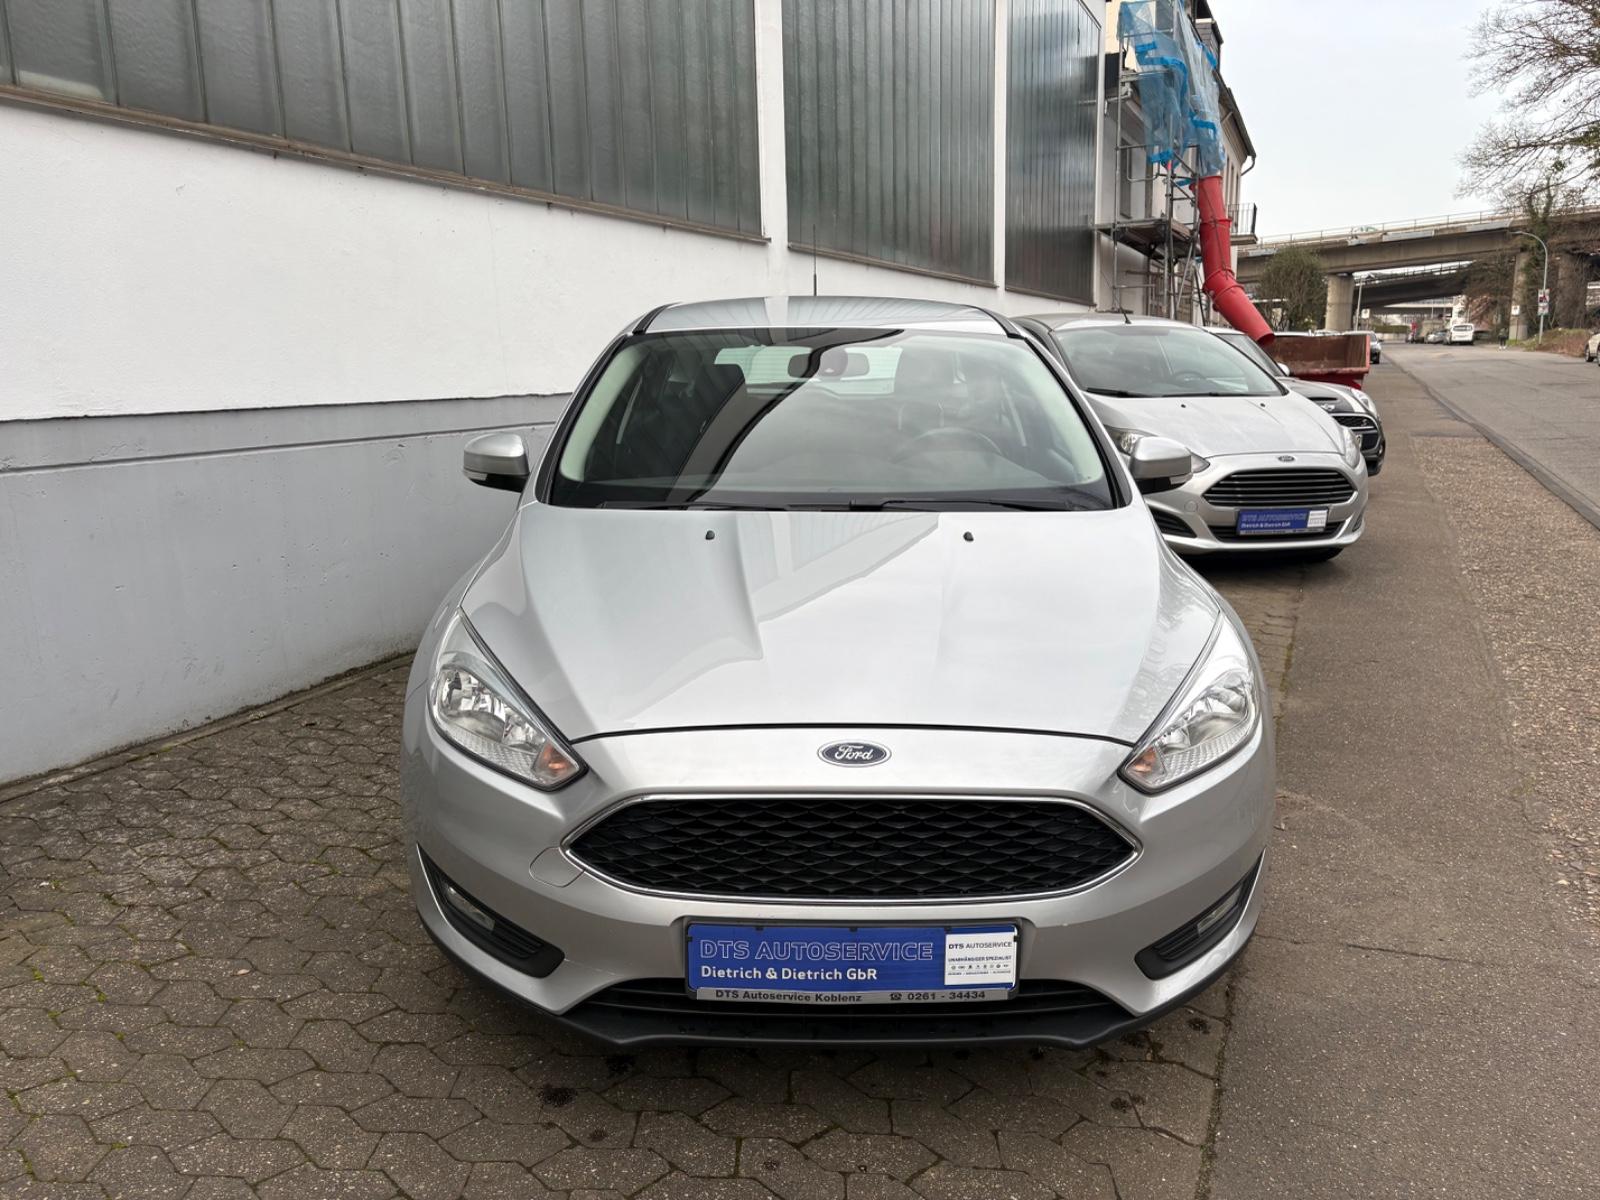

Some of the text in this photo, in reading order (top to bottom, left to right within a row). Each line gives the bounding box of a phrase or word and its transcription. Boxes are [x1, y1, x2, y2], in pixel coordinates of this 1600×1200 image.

[834, 744, 874, 760] Ford
[700, 939, 933, 961] DTS AUTOSERVICE
[965, 941, 1012, 949] AUTOSERVICE
[701, 965, 877, 980] Dietrich & Dietrich GbR
[715, 989, 862, 1003] DTS Autoservice Koblenz
[907, 992, 937, 1001] 0261
[950, 990, 985, 1000] 34434
